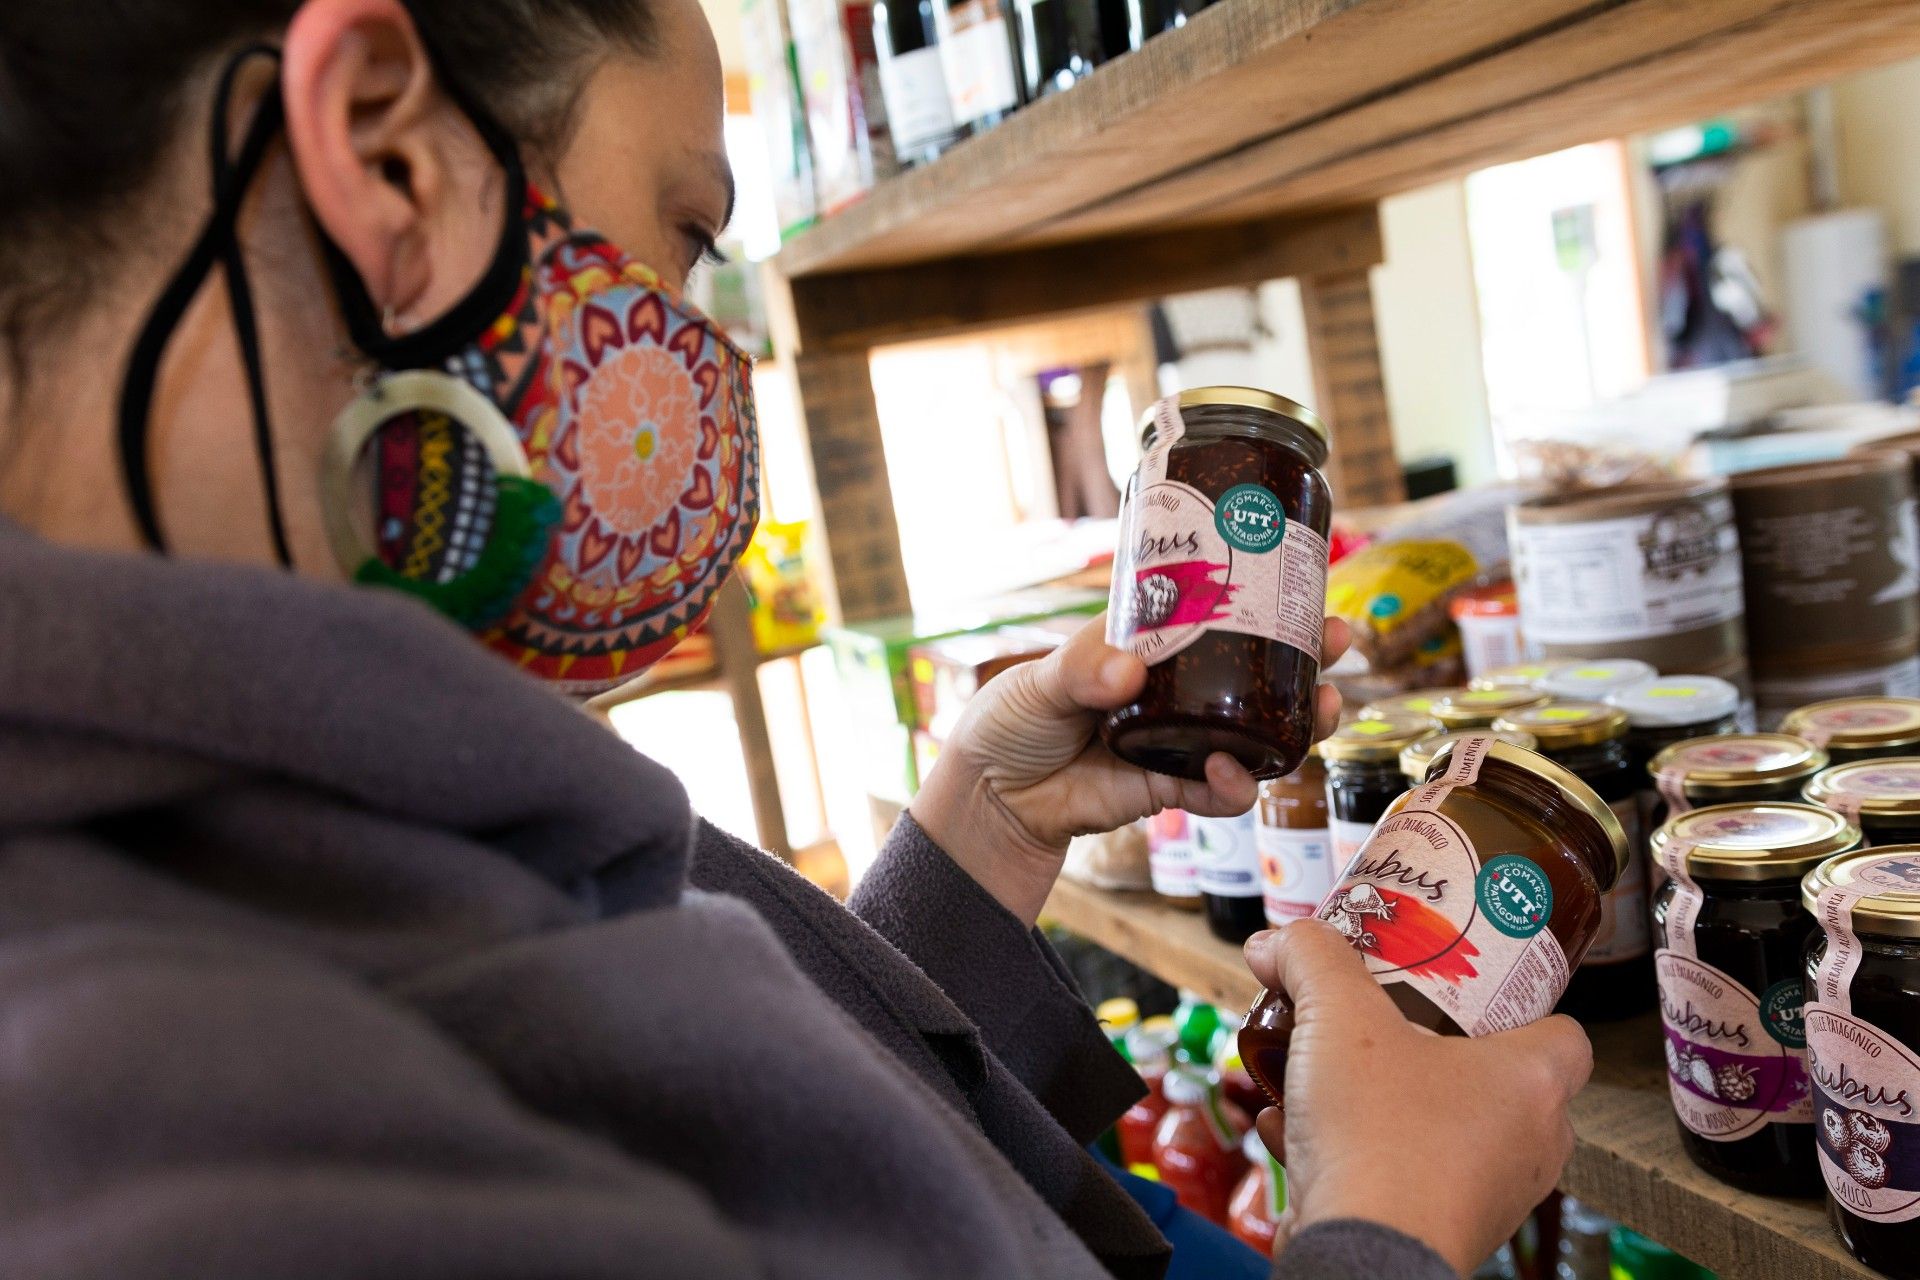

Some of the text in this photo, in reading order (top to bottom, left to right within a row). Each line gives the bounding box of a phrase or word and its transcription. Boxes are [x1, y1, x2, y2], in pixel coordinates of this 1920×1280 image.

[1230, 495, 1275, 517] COMARCA
[1233, 509, 1271, 528] UTT
[1138, 529, 1200, 563] bus
[1229, 521, 1273, 542] PATAGONIA
[1420, 738, 1485, 803] SOBER ALIMENTAR
[1377, 818, 1449, 850] DULCE PATAGÓNICO
[1352, 849, 1449, 901] ubus
[1503, 868, 1543, 909] COMARCA
[1490, 883, 1529, 925] PATAGONIA
[1499, 876, 1536, 915] UTT
[1827, 892, 1851, 999] SOBERANÍA ALIMENTARIA
[1676, 962, 1723, 1000] PATAGÓNICO
[1773, 988, 1801, 1010] COMA
[1659, 985, 1749, 1048] Rubus
[1779, 1005, 1805, 1021] UT
[1826, 1015, 1882, 1059] PATAGÓNICO
[1808, 1043, 1912, 1117] Rubus
[1835, 1175, 1873, 1208] SAUCO
